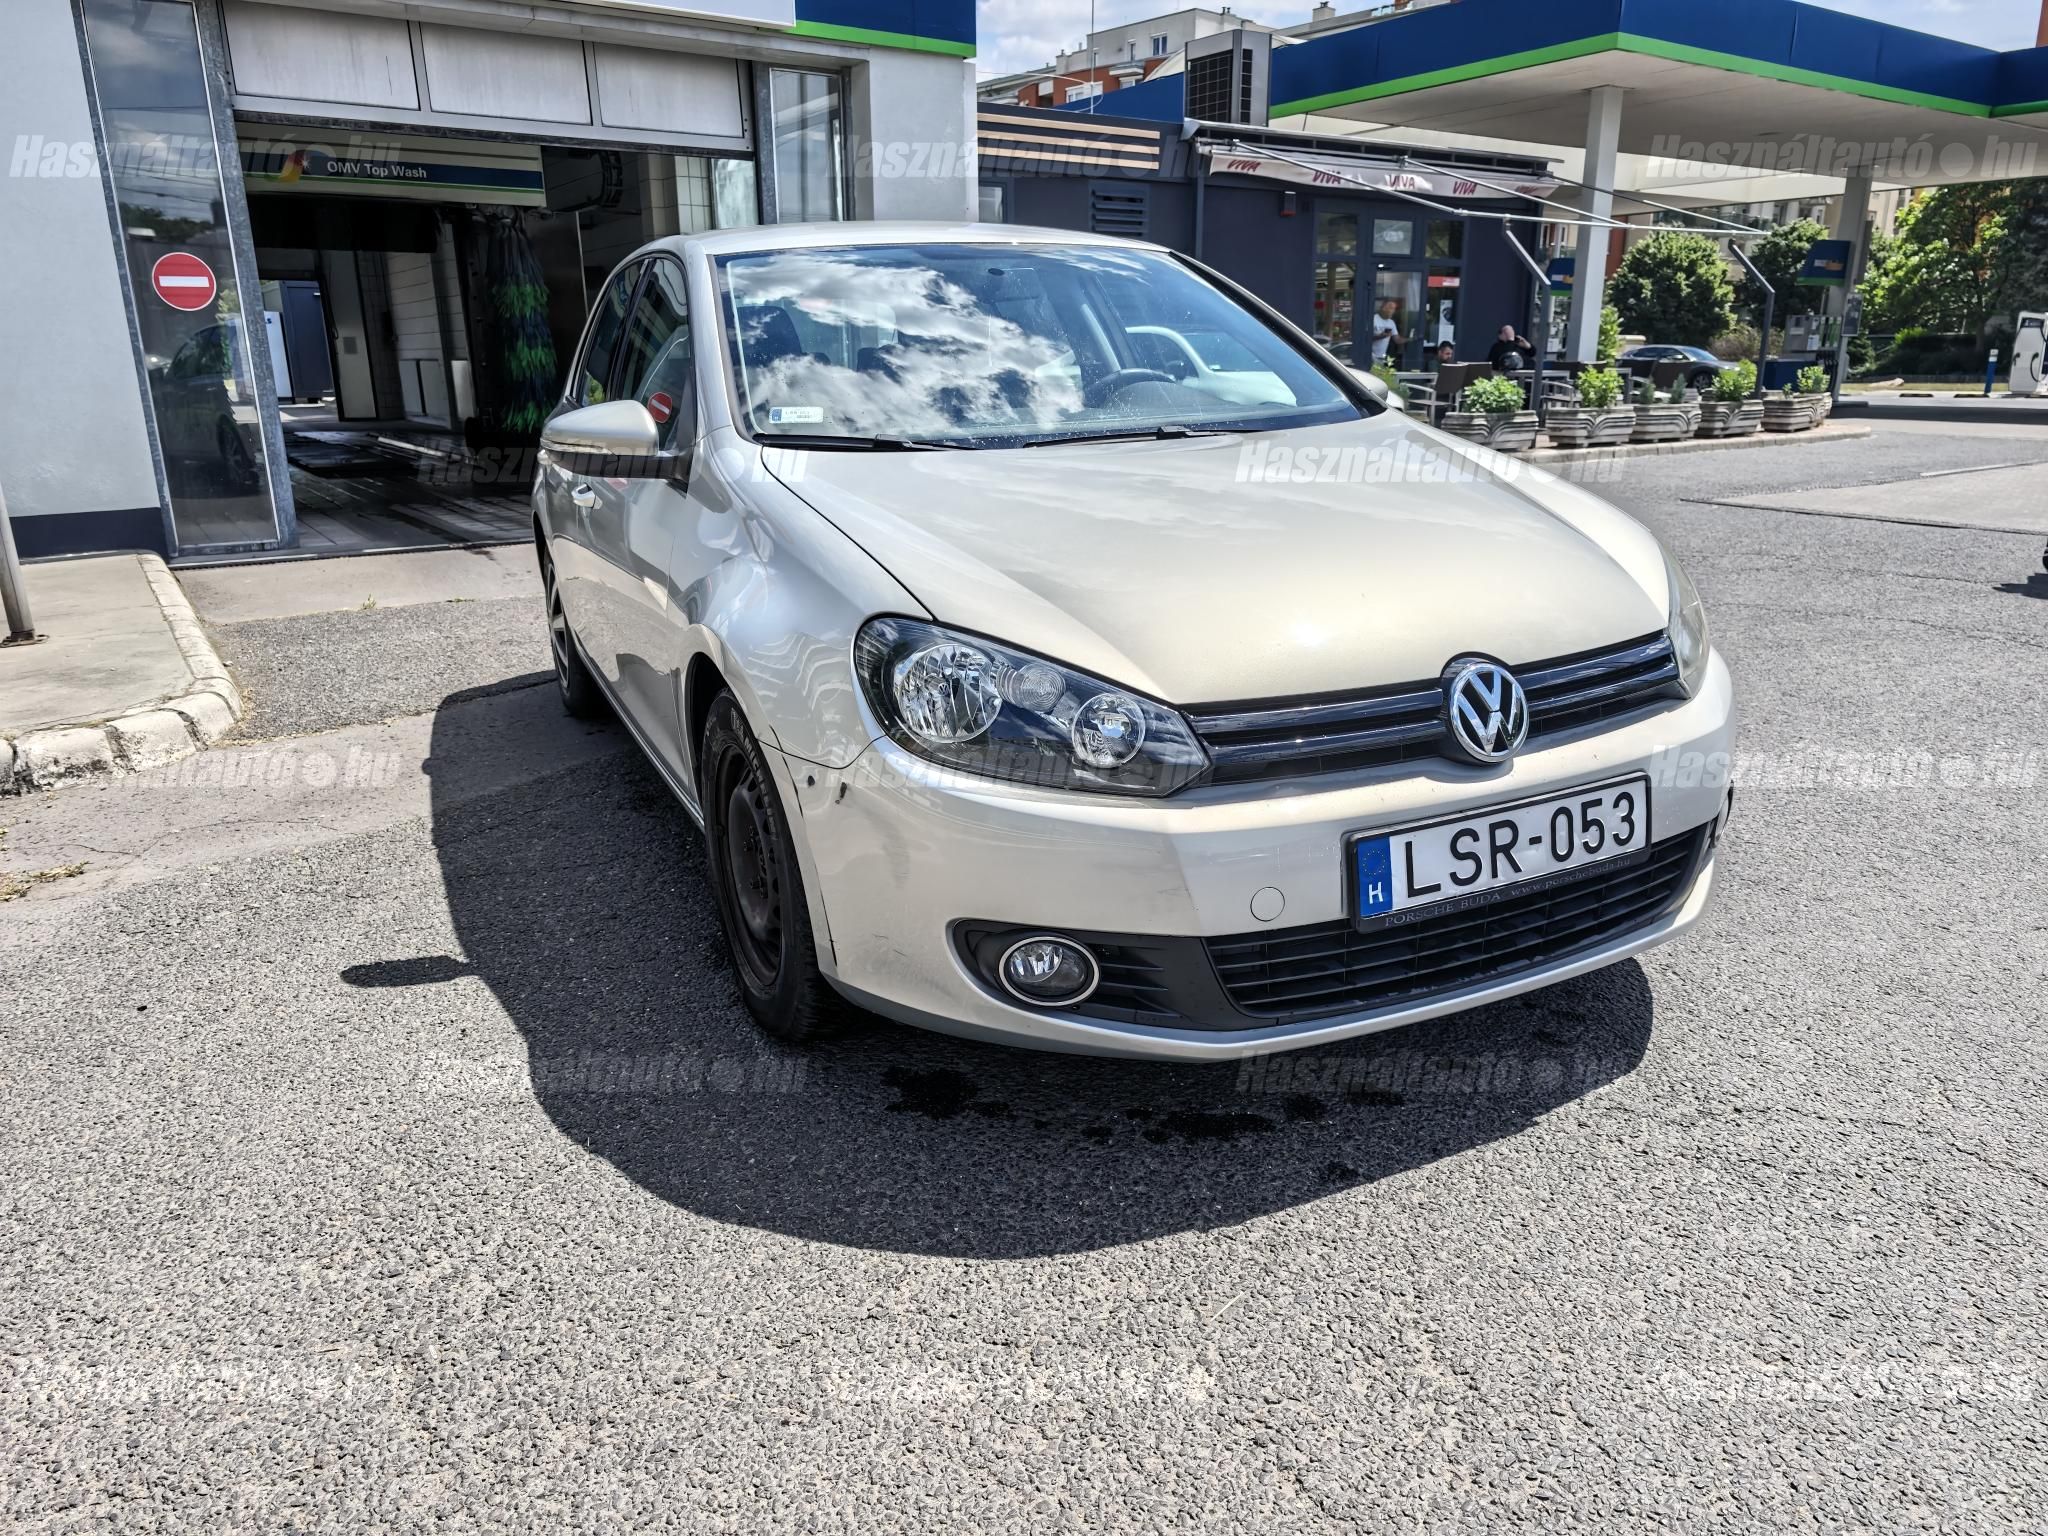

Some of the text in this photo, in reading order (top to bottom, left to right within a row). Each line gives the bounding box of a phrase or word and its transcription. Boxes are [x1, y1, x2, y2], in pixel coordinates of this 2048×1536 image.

[327, 160, 427, 179] OMV Top Wash
[1227, 159, 1261, 172] VIVA
[1311, 170, 1342, 184] VIVA
[1388, 174, 1415, 190] VIVA
[1452, 180, 1478, 195] VIVA
[1405, 791, 1635, 898] LSR-053
[1368, 882, 1384, 905] H
[1385, 858, 1631, 927] PORSCHE BUDA www.porschebuda.hu
